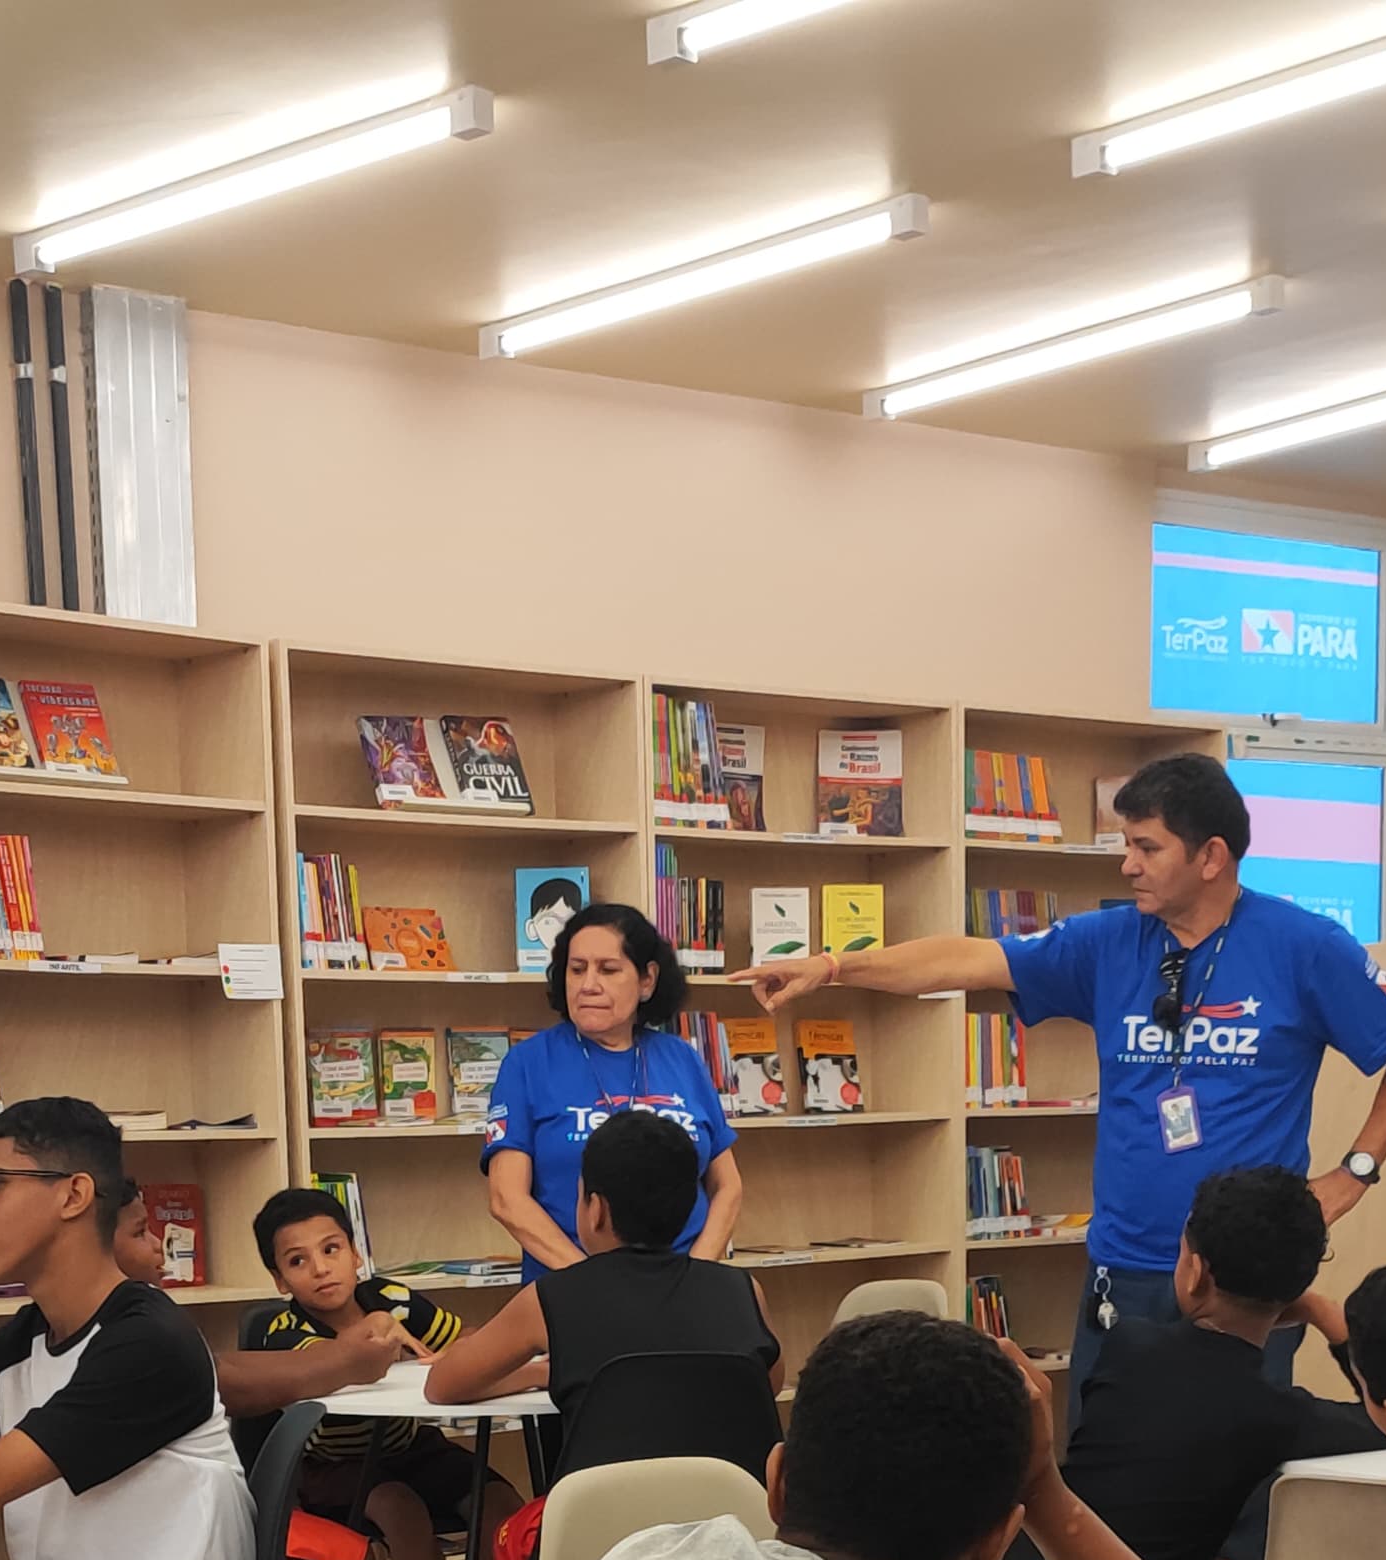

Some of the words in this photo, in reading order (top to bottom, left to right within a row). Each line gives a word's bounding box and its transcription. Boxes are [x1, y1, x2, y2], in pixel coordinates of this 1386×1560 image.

[1161, 625, 1229, 655] TerPaz
[463, 763, 515, 777] GUERRA
[468, 776, 530, 797] CIVIL
[1123, 1015, 1261, 1055] TerPaz
[1117, 1054, 1193, 1065] TERRITÓROS
[1196, 1056, 1227, 1066] PELA
[1231, 1057, 1256, 1066] PAZ
